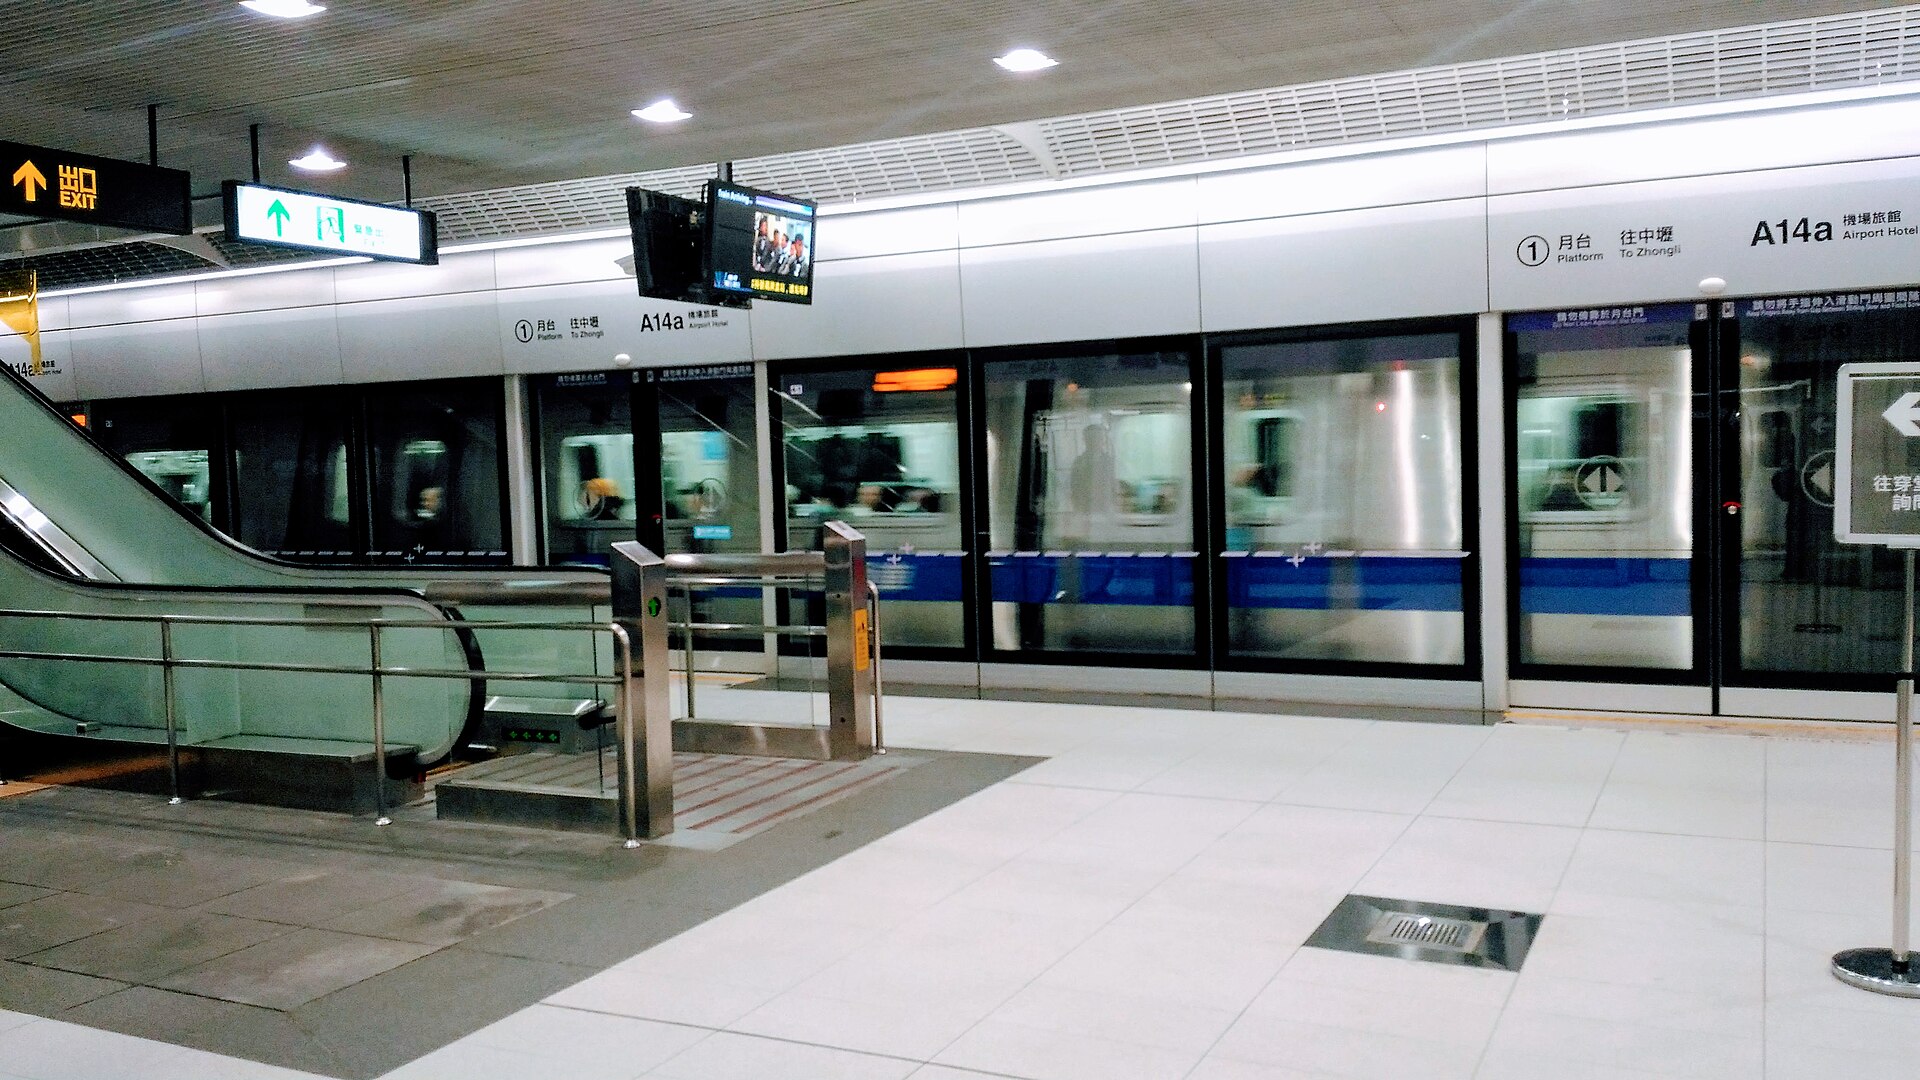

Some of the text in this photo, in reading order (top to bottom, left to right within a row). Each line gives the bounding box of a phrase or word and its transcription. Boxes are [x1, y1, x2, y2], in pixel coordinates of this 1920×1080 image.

[59, 165, 96, 194] 出口
[60, 191, 97, 209] EXIT
[1843, 210, 1901, 226] 機場旅館
[1559, 226, 1673, 250] 月台 往中壢
[1751, 217, 1833, 246] A14a
[1843, 226, 1919, 240] Airport Hotel
[1558, 252, 1604, 263] Platform
[1620, 245, 1681, 258] To Zhongli
[538, 320, 555, 331] 月台
[641, 312, 684, 332] A14a
